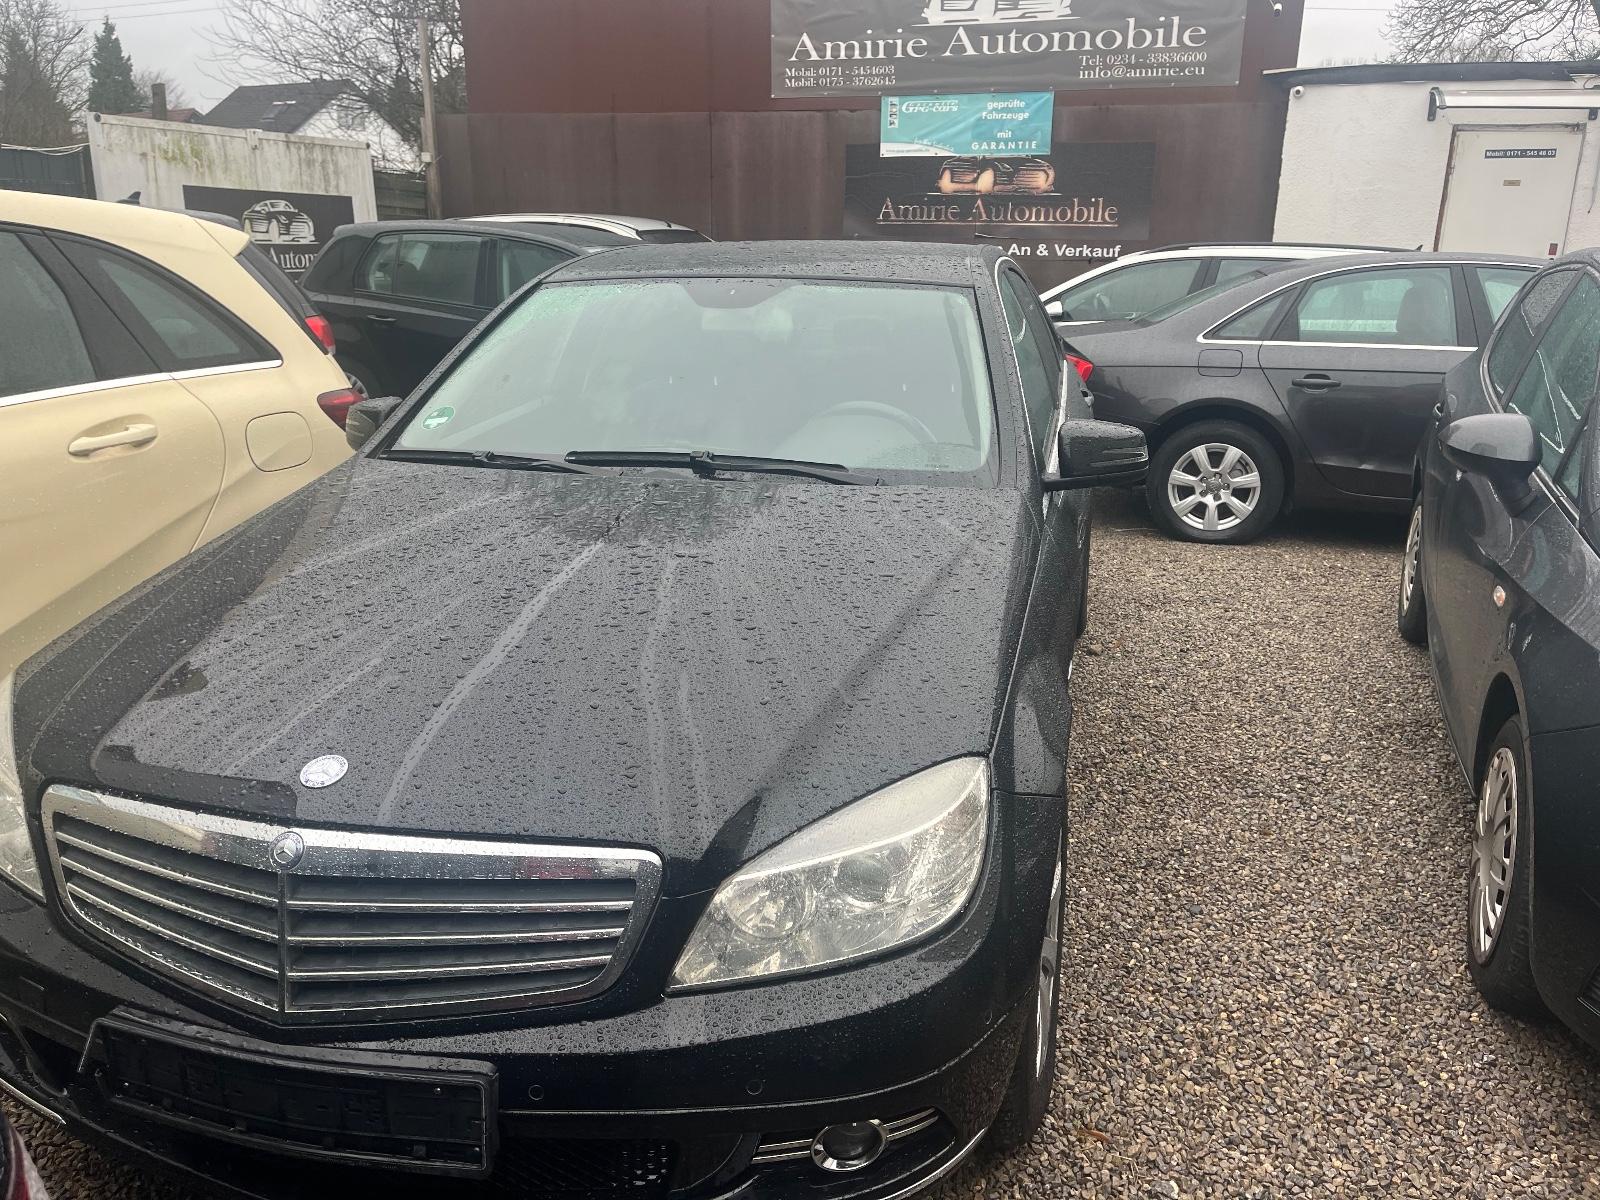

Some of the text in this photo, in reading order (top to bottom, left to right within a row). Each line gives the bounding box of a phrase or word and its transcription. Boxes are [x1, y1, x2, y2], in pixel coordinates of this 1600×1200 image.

[788, 16, 1207, 61] Amirie Automobile
[1079, 55, 1103, 66] Tel:
[1106, 54, 1136, 65] 0234
[1146, 51, 1207, 64] 33836600
[785, 67, 817, 77] Mobil:
[818, 66, 842, 76] 0171
[851, 64, 895, 76] 5454603
[1080, 64, 1205, 79] info@amirie.eu
[785, 78, 817, 88] Mobil:
[818, 77, 844, 87] 0175
[852, 76, 896, 86] 3762645
[987, 99, 1026, 110] geprüfte
[982, 111, 1030, 121] Fahrzeuge
[996, 130, 1012, 139] mit
[971, 141, 1037, 150] GARANTIE
[876, 197, 1119, 223] Amirie Automobile
[1008, 243, 1122, 258] An & Verkauf
